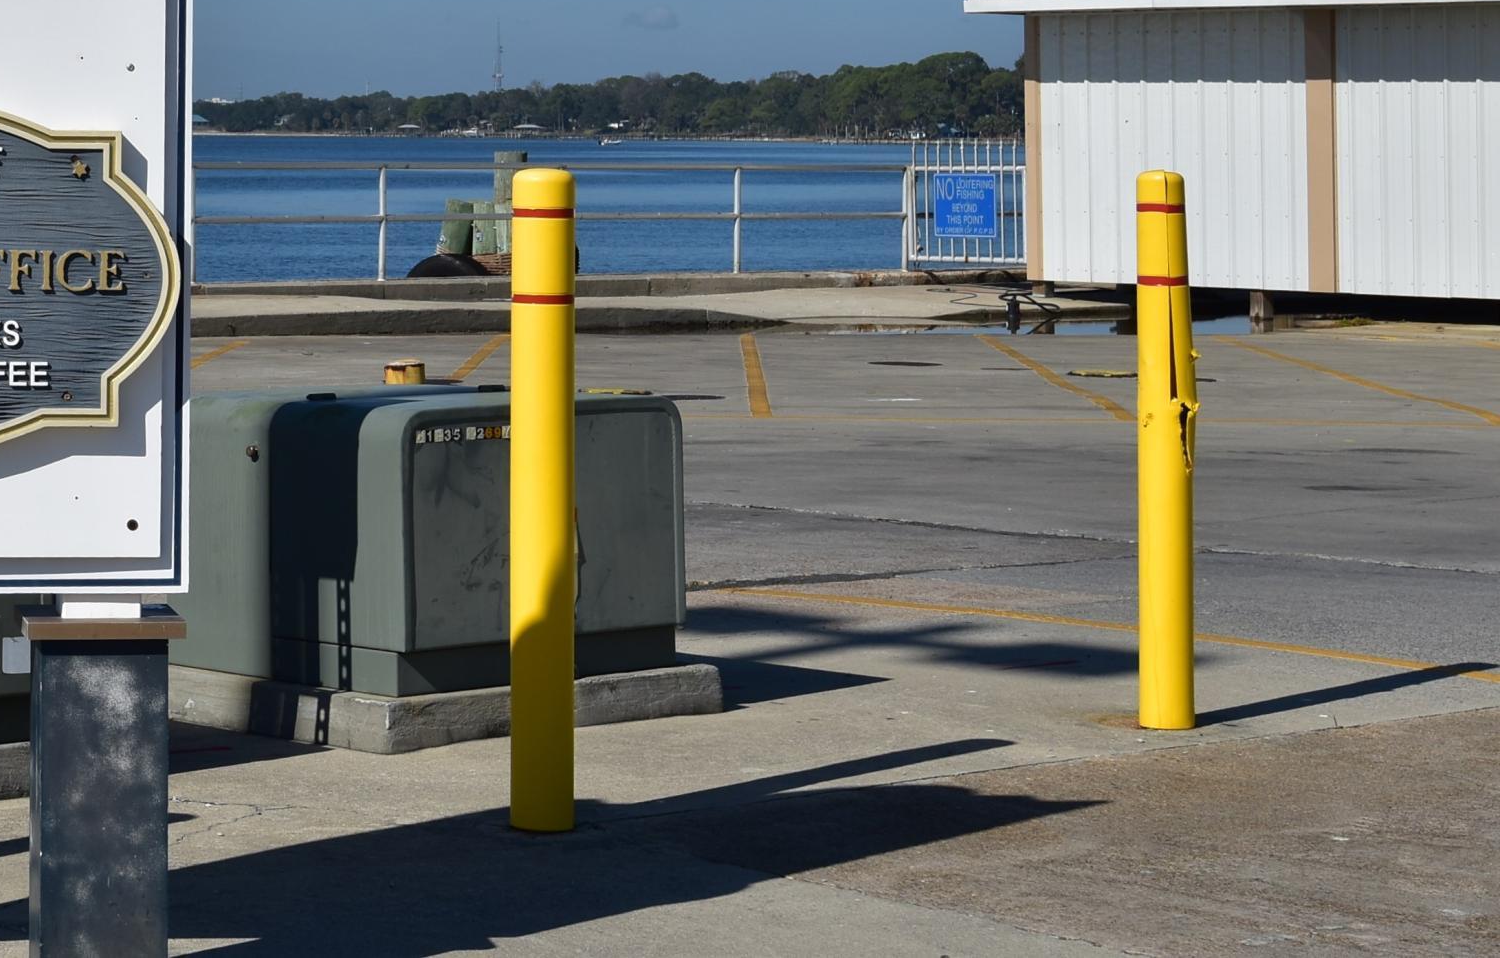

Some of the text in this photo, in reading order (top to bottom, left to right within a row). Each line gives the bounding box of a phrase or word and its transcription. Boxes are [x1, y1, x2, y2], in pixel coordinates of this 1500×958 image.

[936, 177, 954, 200] NO
[956, 189, 985, 200] FISHING
[946, 214, 984, 225] THIS POINT
